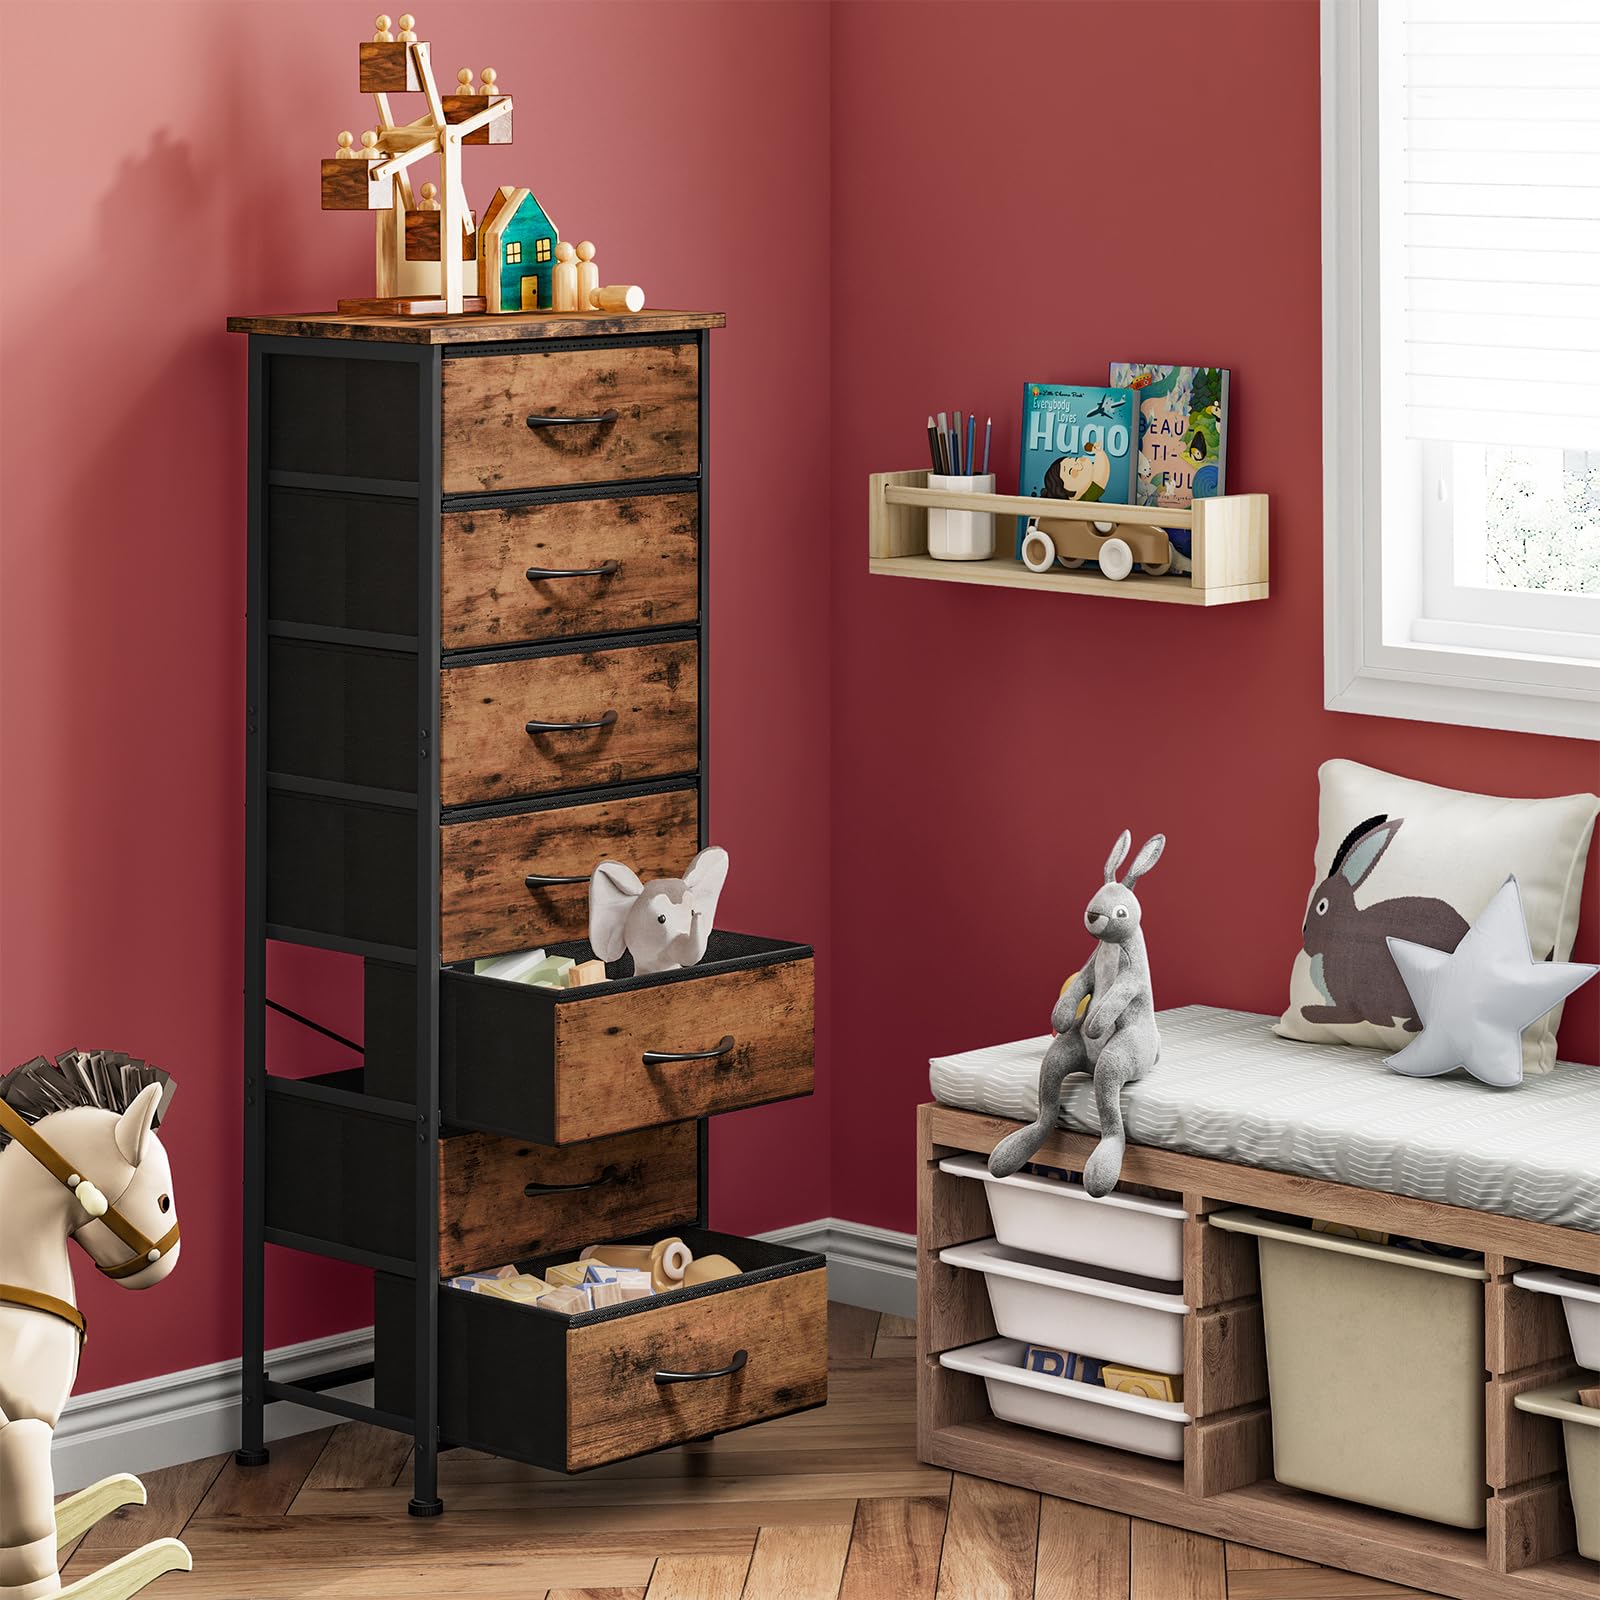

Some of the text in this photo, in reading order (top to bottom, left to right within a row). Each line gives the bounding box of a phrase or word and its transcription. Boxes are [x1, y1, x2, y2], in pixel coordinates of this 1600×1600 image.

[1033, 397, 1071, 412] Everybody
[1057, 412, 1077, 423] Loves
[1029, 411, 1129, 457] Hugo
[1151, 444, 1178, 461] TI-
[1162, 471, 1193, 489] FUL
